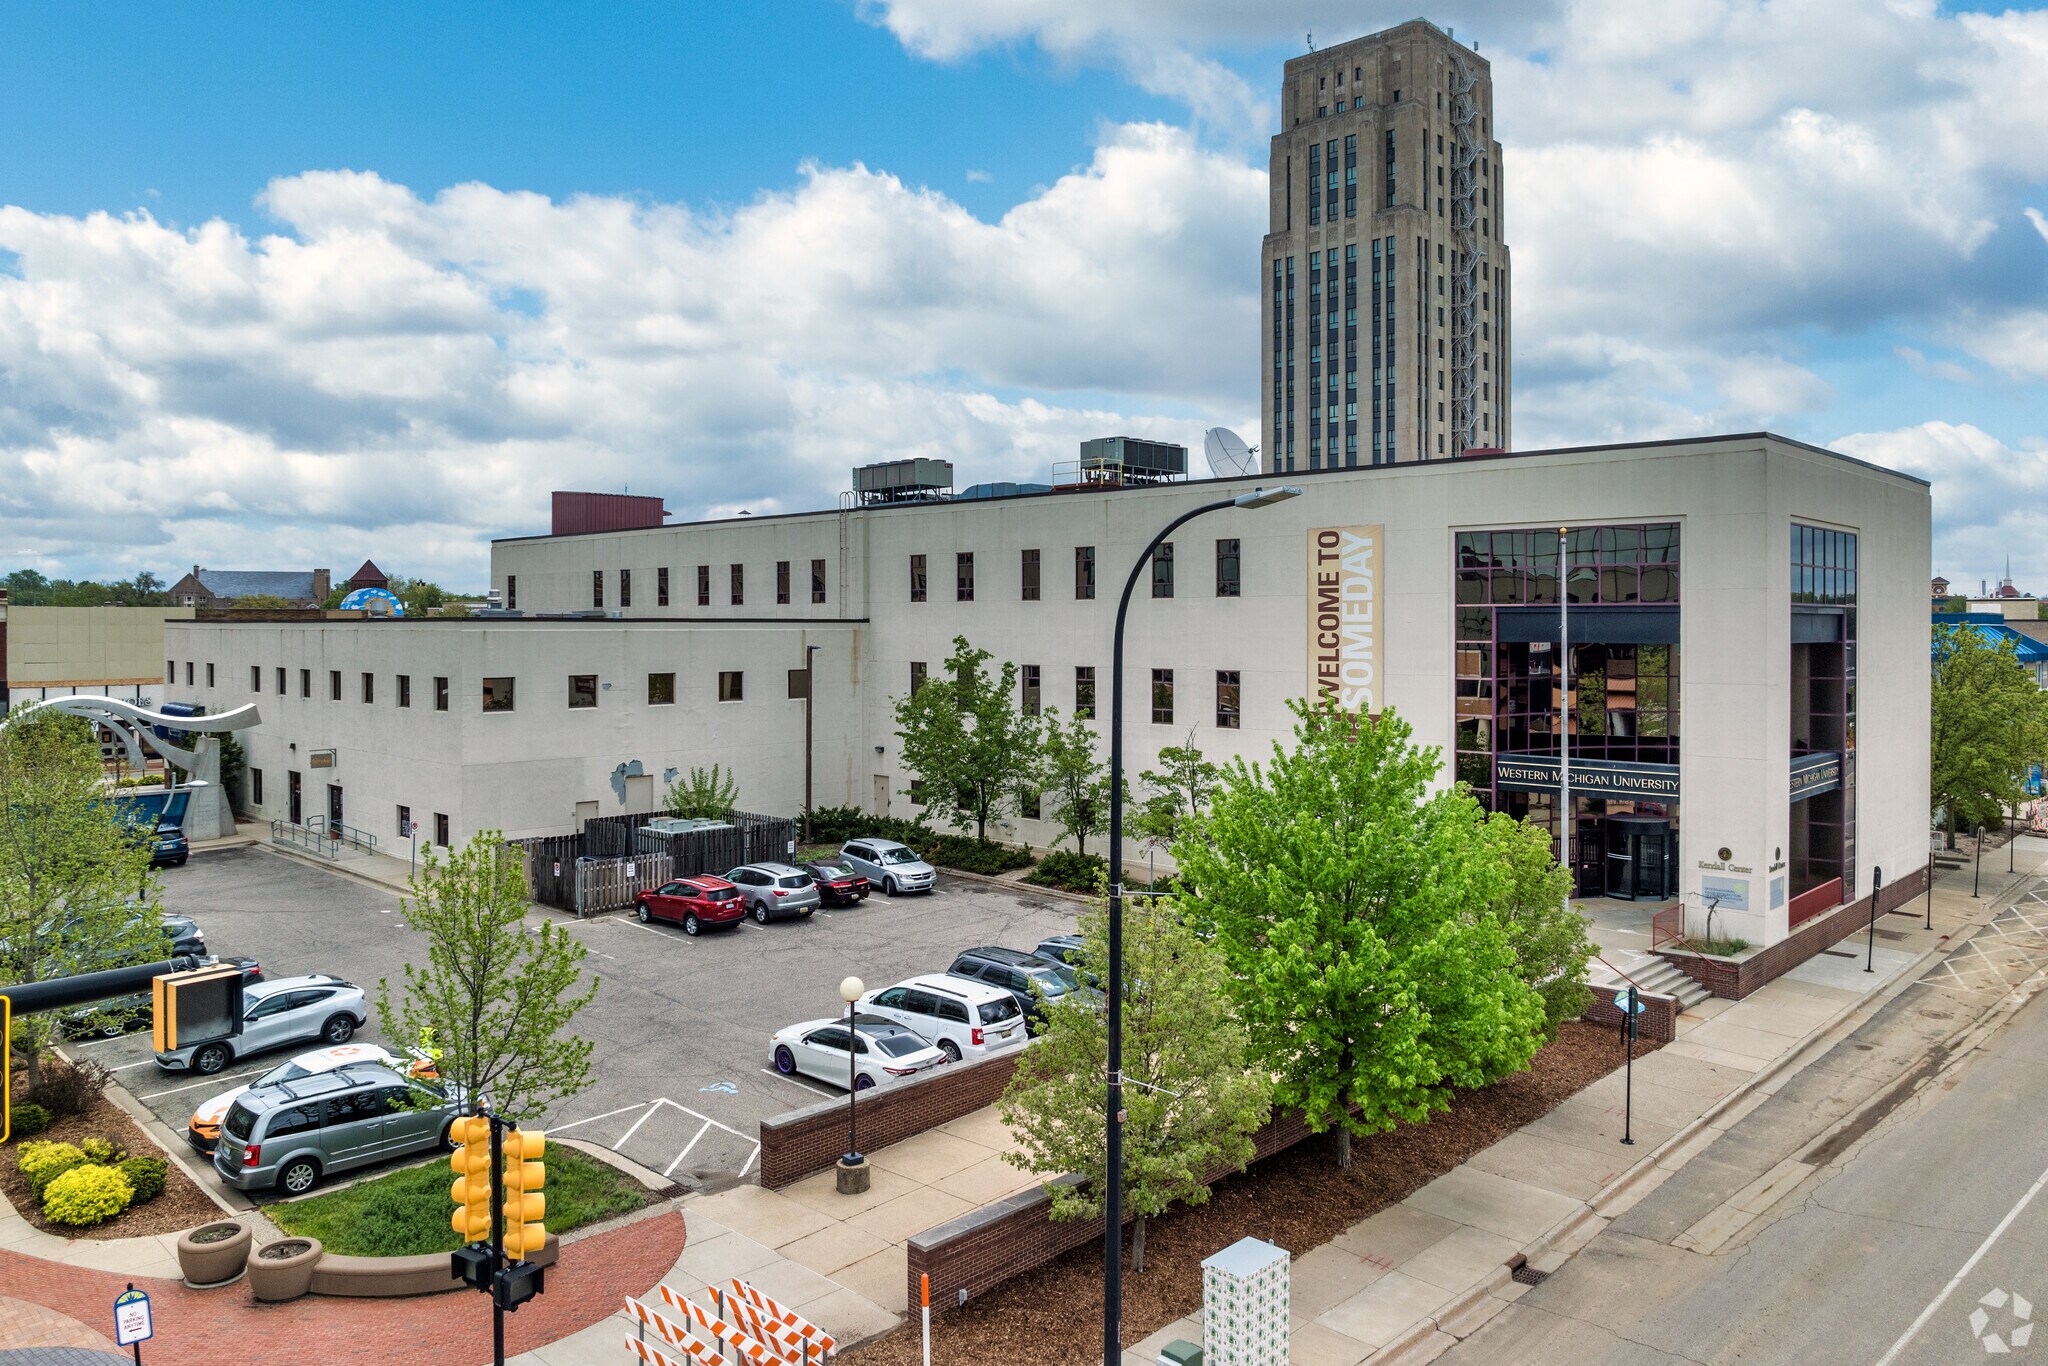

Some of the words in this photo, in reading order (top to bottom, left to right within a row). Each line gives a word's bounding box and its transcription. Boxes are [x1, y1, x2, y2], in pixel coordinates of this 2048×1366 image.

[1317, 530, 1340, 566] TO
[1341, 531, 1374, 710] SOMEDAY
[1317, 571, 1340, 708] WELCOME
[1497, 766, 1549, 781] WESTERN
[1552, 770, 1609, 785] MCHIGAN
[1613, 775, 1680, 791] UNIVERSITY
[1698, 860, 1725, 871] Kendall
[1728, 864, 1752, 873] Center
[123, 1315, 144, 1324] PARKING
[124, 1320, 144, 1329] ANYTIME
